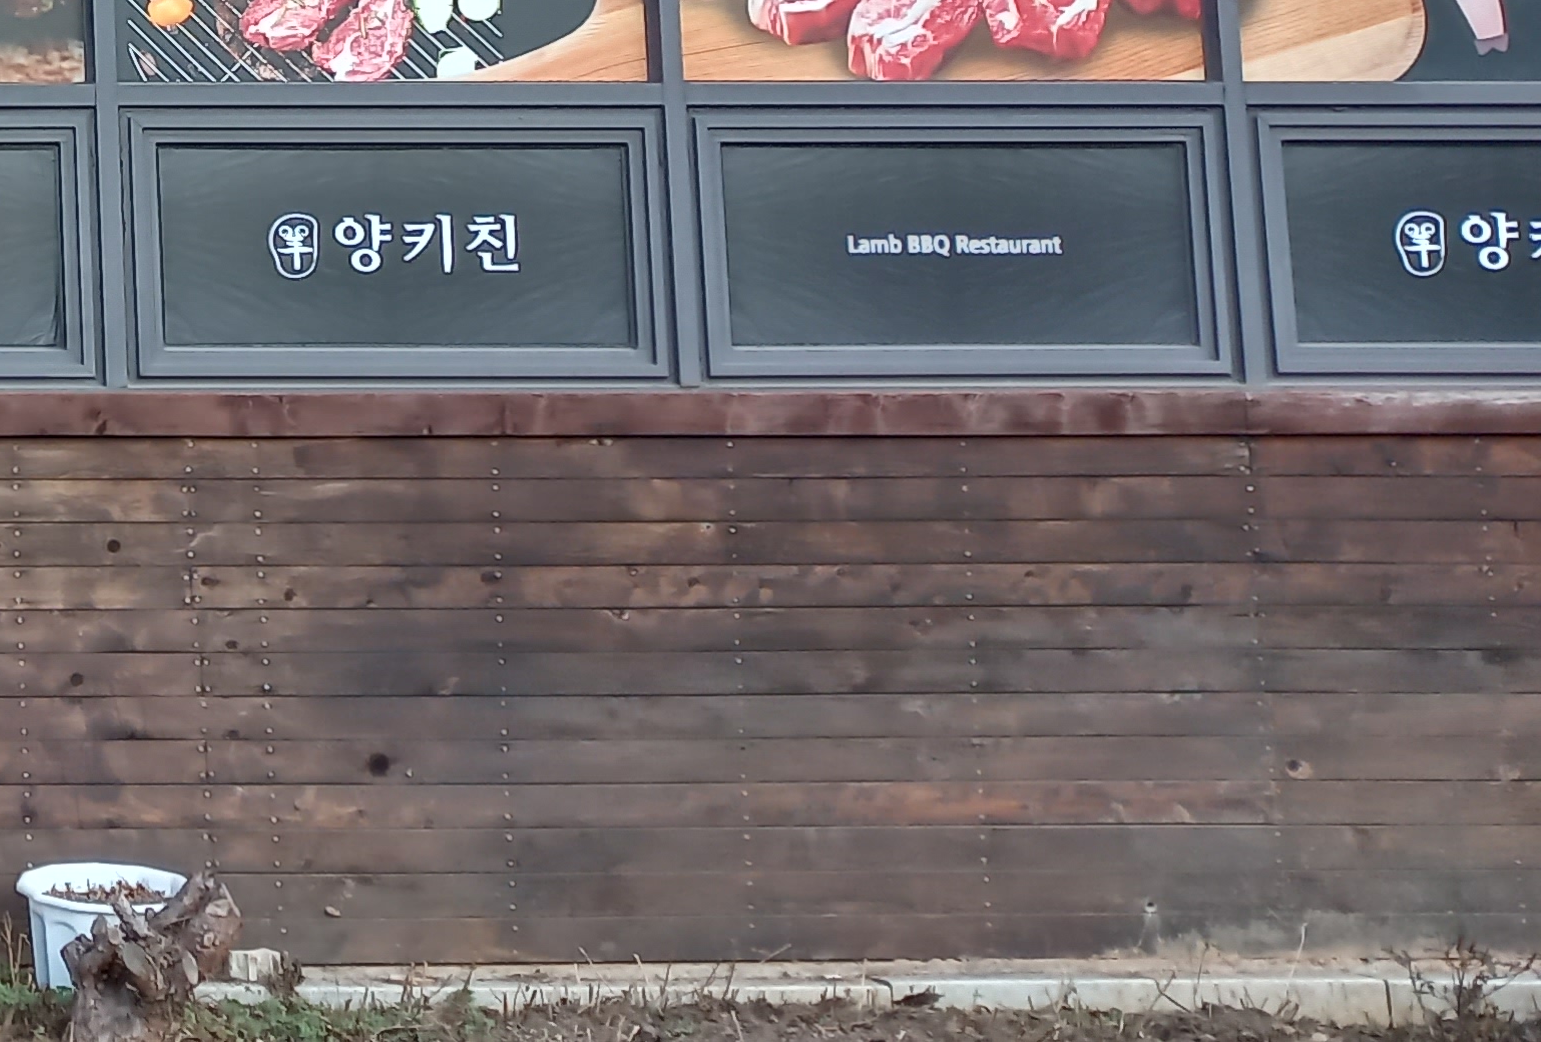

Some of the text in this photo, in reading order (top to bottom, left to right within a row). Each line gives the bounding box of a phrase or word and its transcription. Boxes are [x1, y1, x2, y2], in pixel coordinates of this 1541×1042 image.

[334, 213, 520, 273] 양키친
[847, 233, 1063, 257] Lamb BBQ Restaurant
